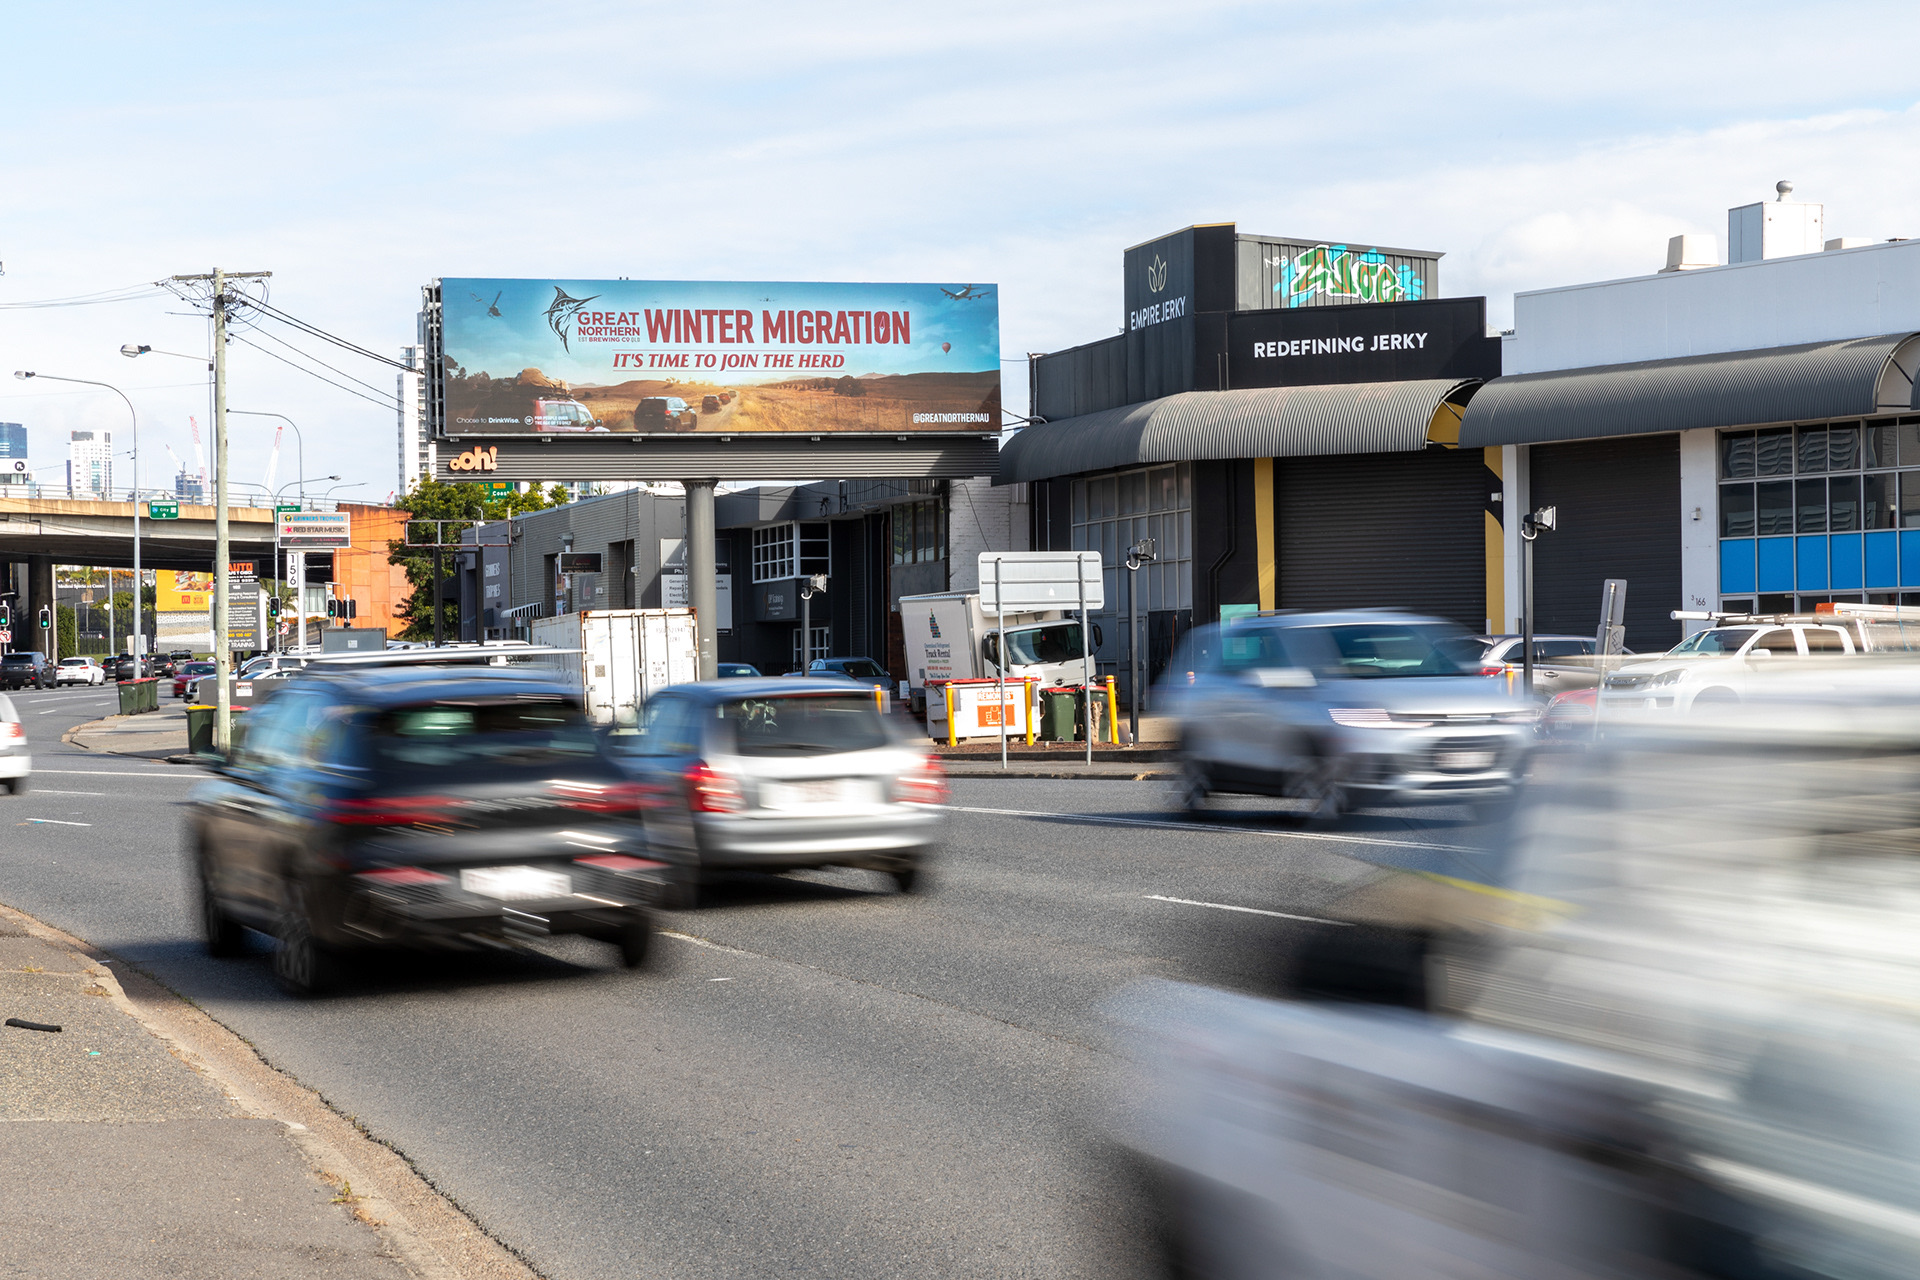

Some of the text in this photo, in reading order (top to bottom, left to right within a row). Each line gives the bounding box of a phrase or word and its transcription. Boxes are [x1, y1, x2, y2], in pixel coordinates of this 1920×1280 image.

[577, 311, 640, 326] GREAT
[1130, 296, 1186, 331] EMPIRE JERKY
[577, 326, 640, 336] NORTHERN
[644, 308, 911, 345] WINTER MIGRATION
[1254, 332, 1428, 358] REDEFINING JERKY
[612, 353, 845, 372] IT'S TIME TO JOIN THE HERD
[456, 416, 480, 424] Choose
[480, 416, 488, 424] to
[912, 412, 990, 424] @GREATNORTHERNAU
[228, 563, 253, 571] AUTO
[1695, 598, 1706, 606] 166
[925, 649, 951, 658] Truck Rental
